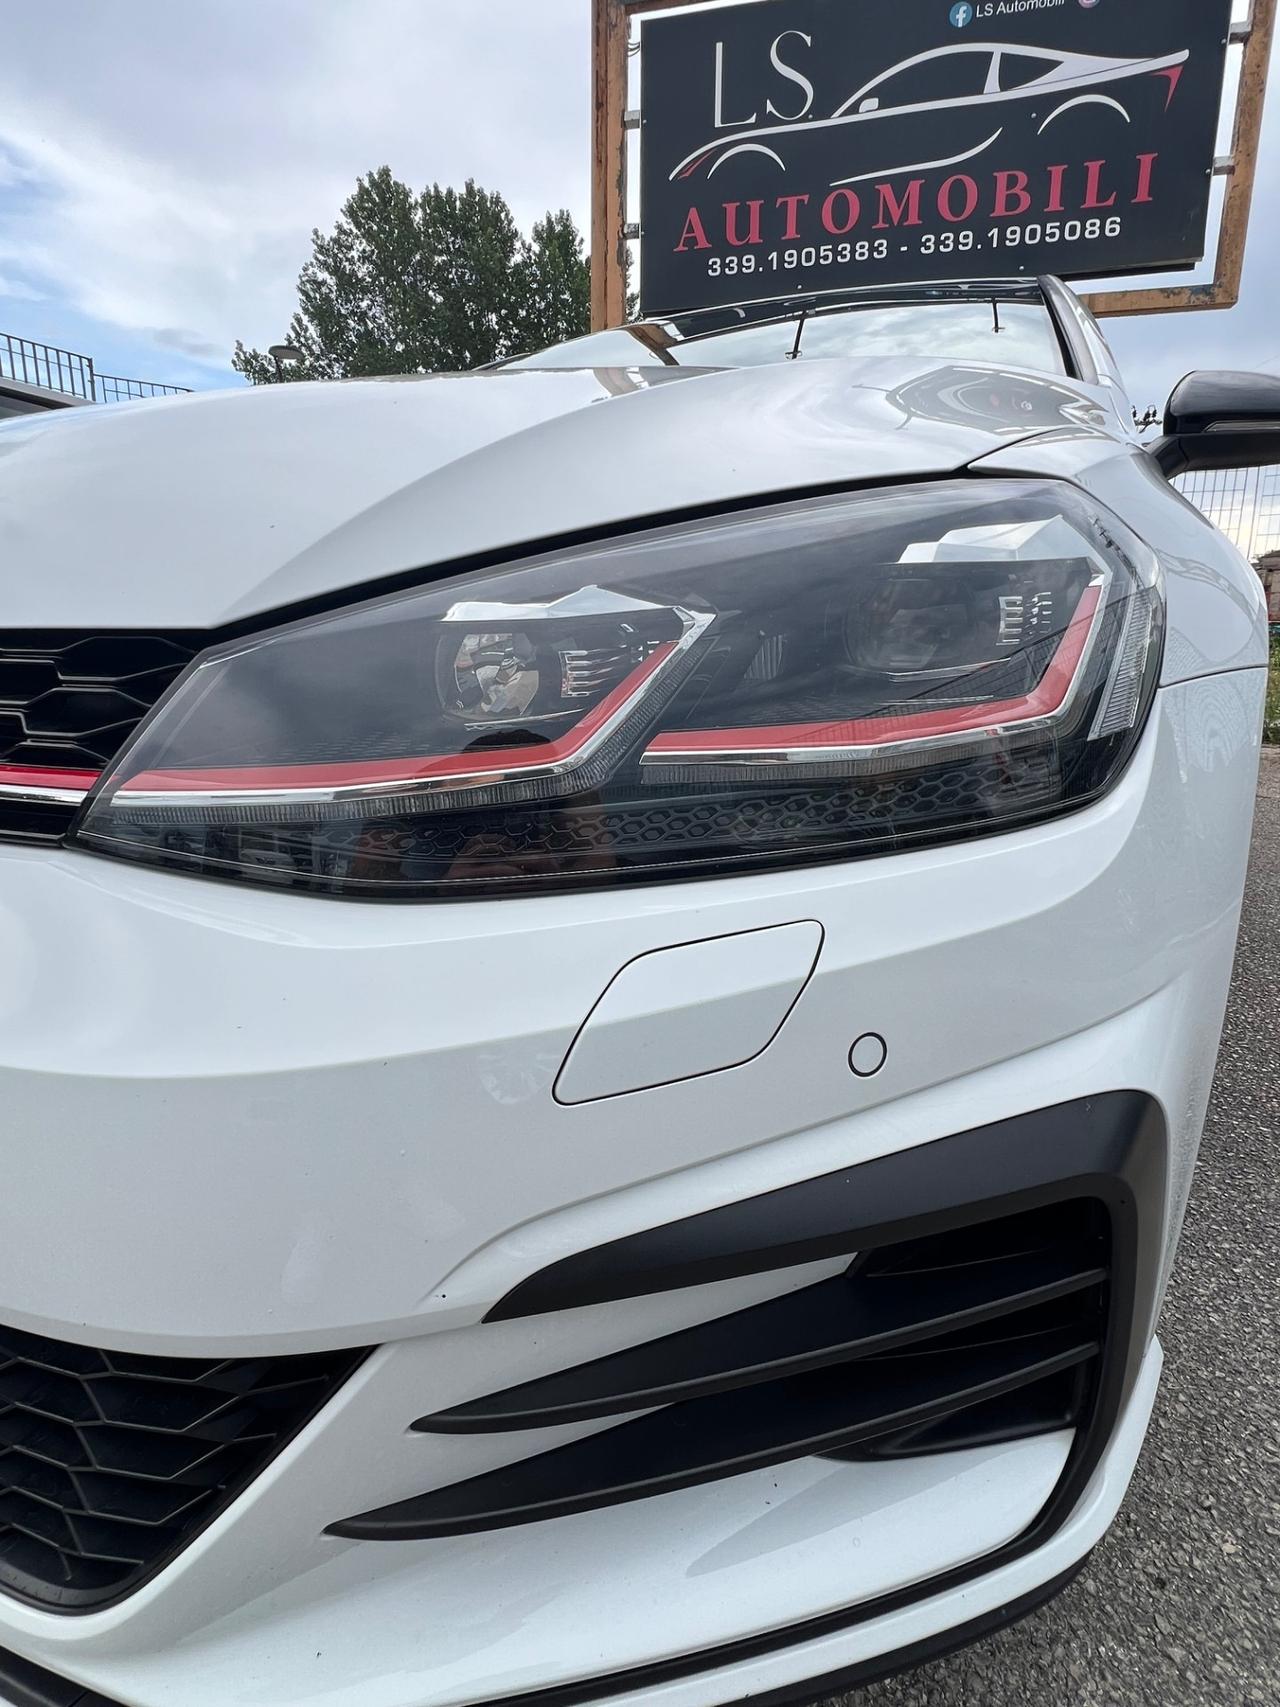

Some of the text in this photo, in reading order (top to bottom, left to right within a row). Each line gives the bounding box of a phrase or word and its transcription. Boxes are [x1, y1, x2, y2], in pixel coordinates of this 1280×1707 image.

[976, 3, 994, 18] LS
[673, 153, 1160, 253] AUTOMOBILI
[707, 239, 888, 277] 339.1905383
[920, 216, 1121, 254] 339.1905086
